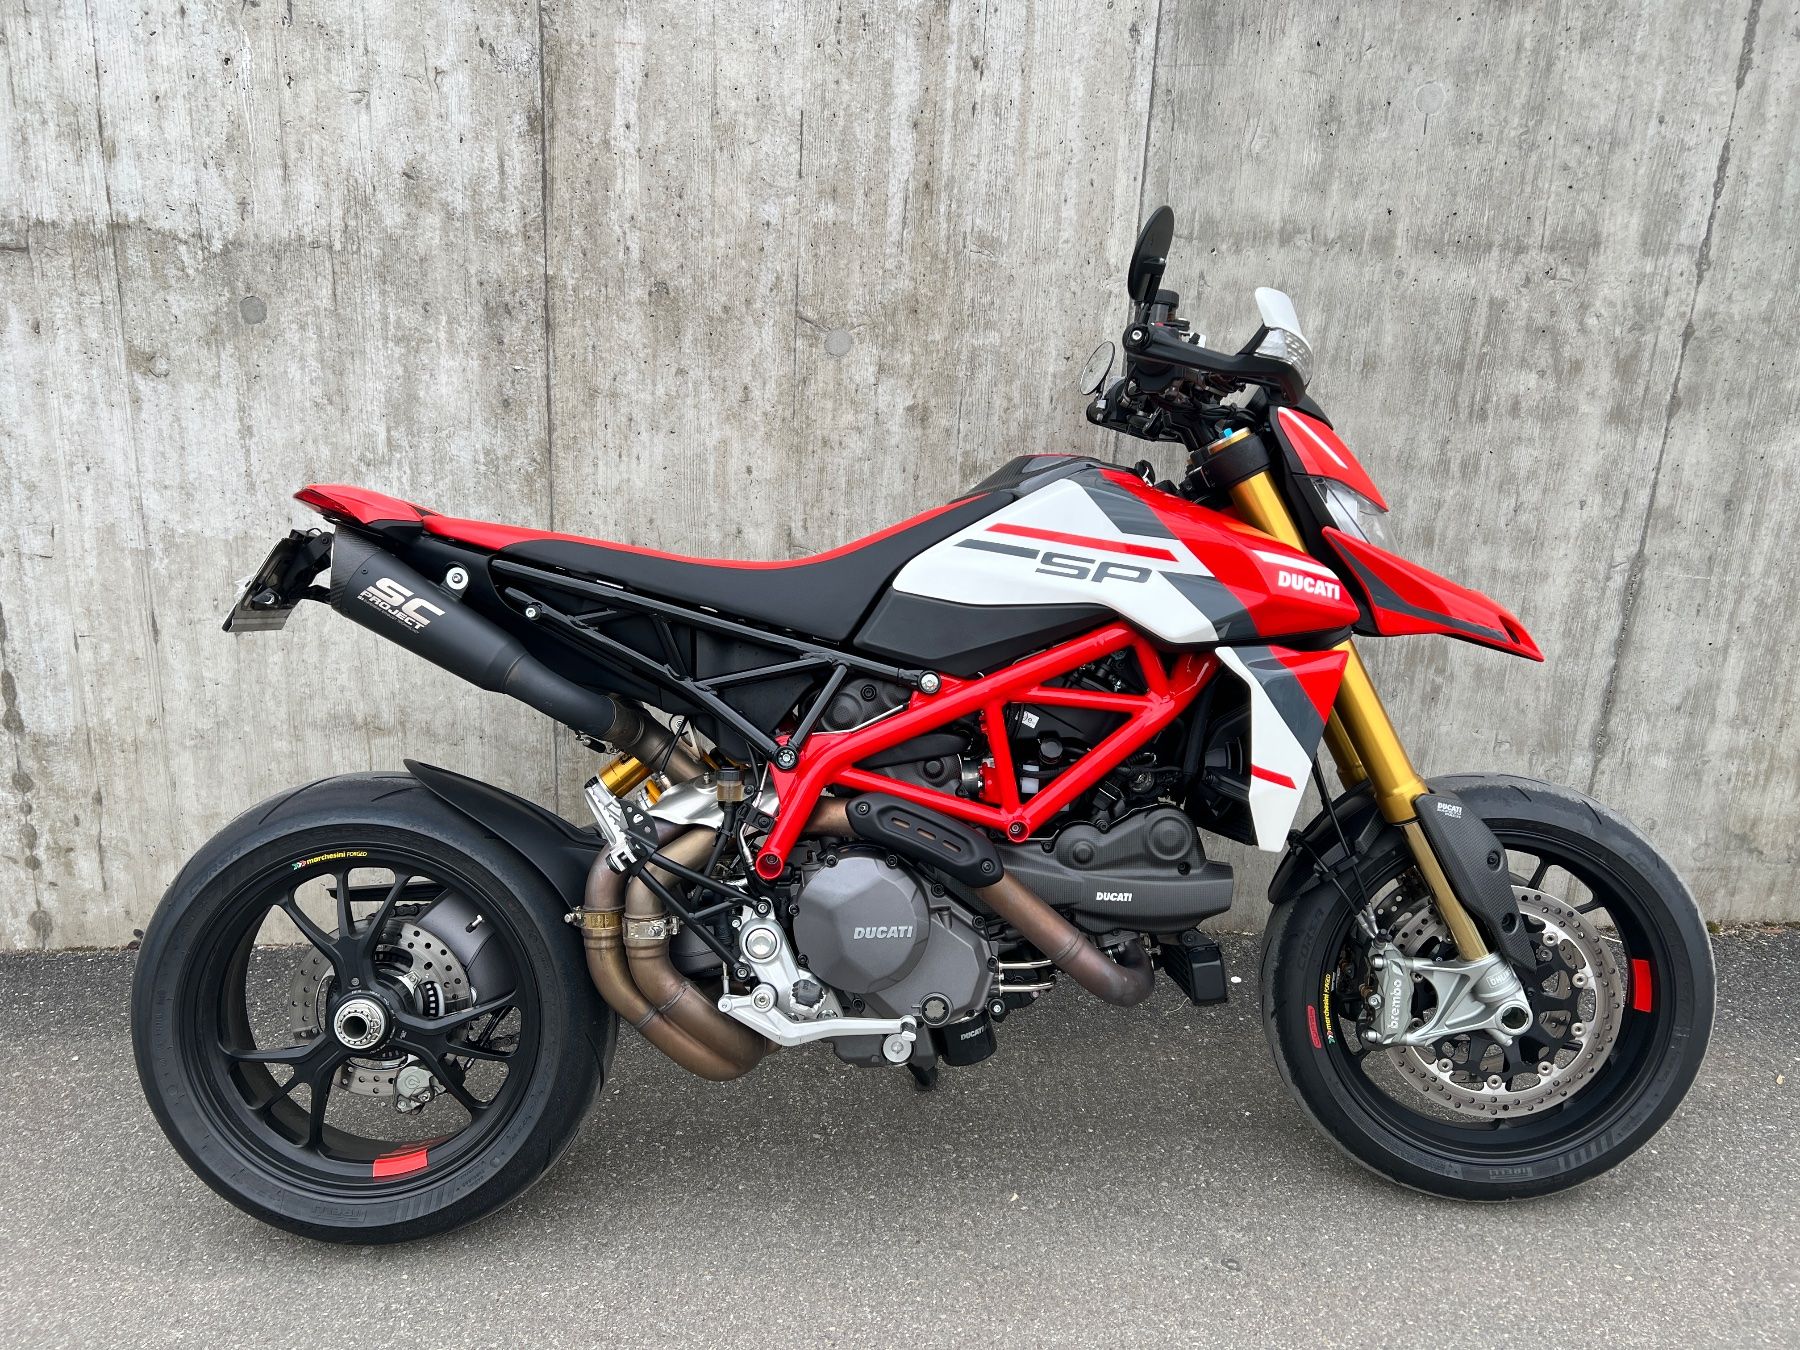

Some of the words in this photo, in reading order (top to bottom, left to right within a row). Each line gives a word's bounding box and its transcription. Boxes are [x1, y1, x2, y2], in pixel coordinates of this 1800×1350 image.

[1035, 552, 1153, 584] SP
[1278, 570, 1340, 600] DUCATI
[360, 590, 425, 630] PROJECT
[366, 577, 447, 626] SC
[1437, 802, 1462, 813] DUCATI
[306, 851, 346, 865] marchesini
[1096, 892, 1133, 902] DUCATI
[853, 925, 914, 940] DUCATI
[1323, 993, 1332, 1031] marchesini
[1388, 979, 1402, 1029] brembo
[960, 1023, 988, 1041] DUCATI
